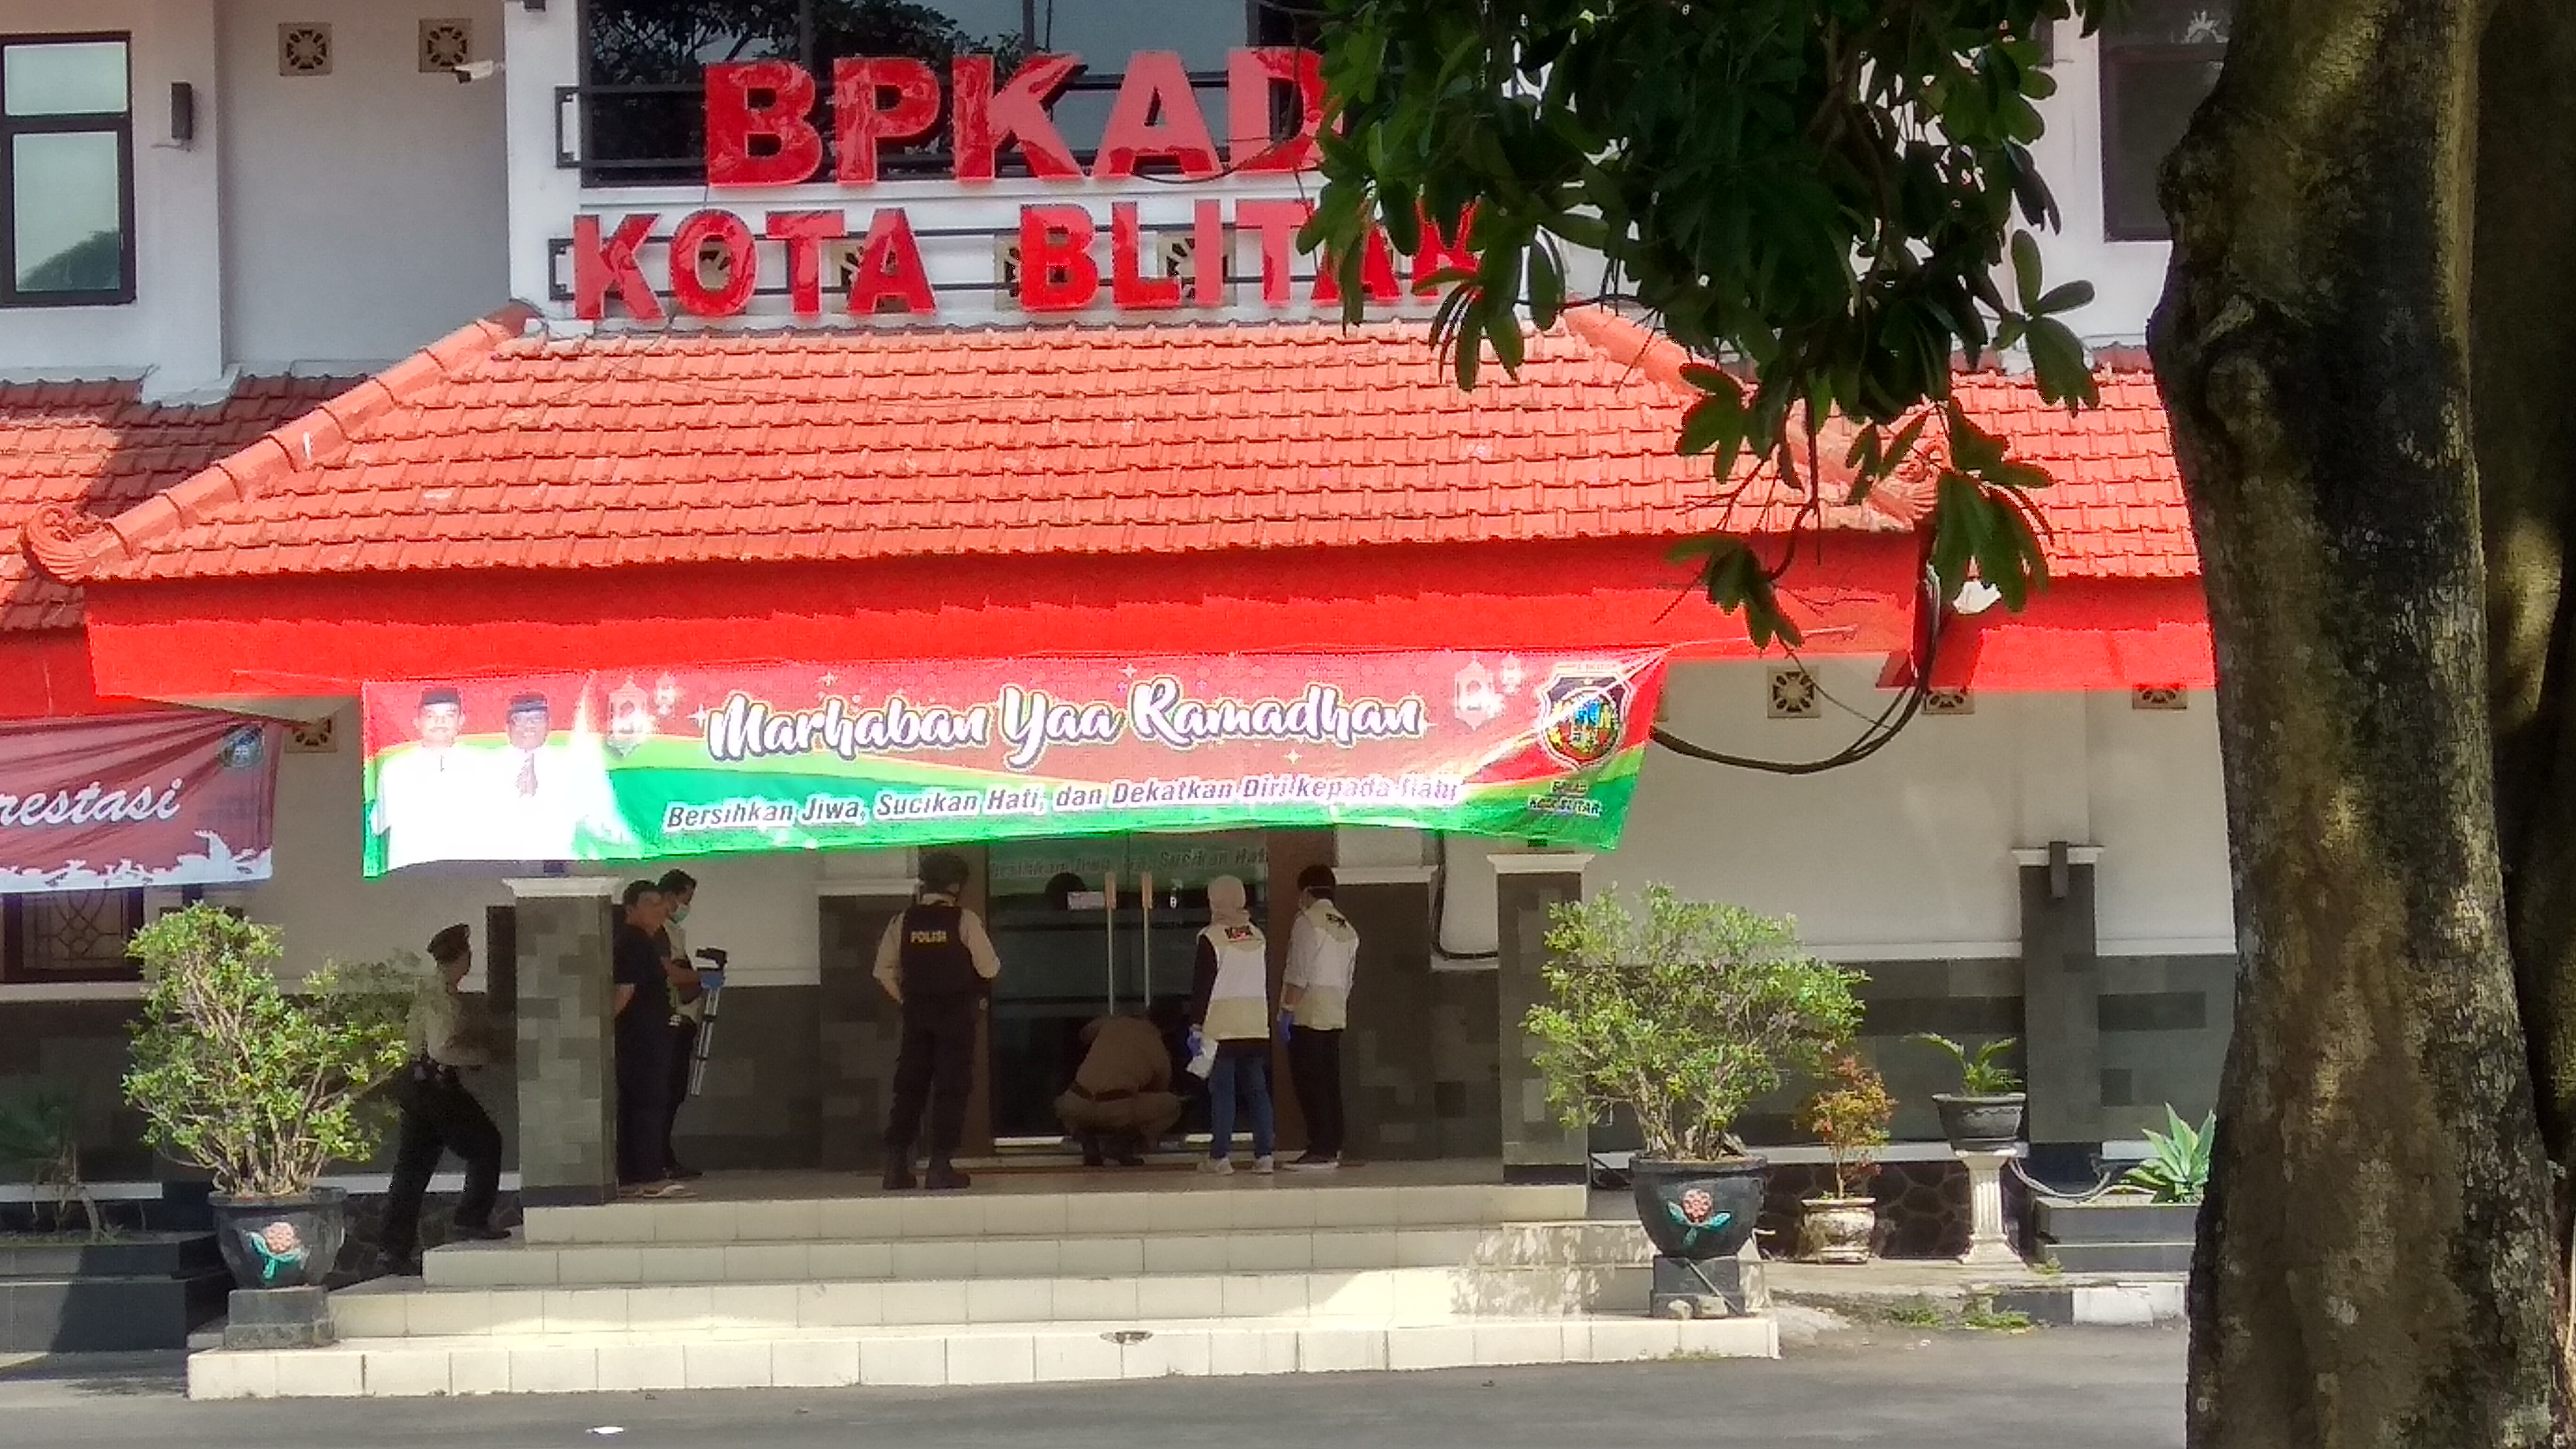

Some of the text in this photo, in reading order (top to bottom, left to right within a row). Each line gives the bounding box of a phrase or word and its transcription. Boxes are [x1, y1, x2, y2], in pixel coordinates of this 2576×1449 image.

[704, 47, 1340, 187] BPKAD
[573, 207, 938, 320] KOTA
[709, 676, 1422, 770] Marhaban Yaa Ramadhan
[666, 801, 793, 829] Bersihkan
[801, 797, 866, 822] Jiwa,
[877, 792, 978, 816] Sucikan
[987, 786, 1044, 812] Hati,
[1056, 785, 1102, 806] dan
[1112, 780, 1233, 804] Dekatkan
[911, 929, 947, 943] POLISI
